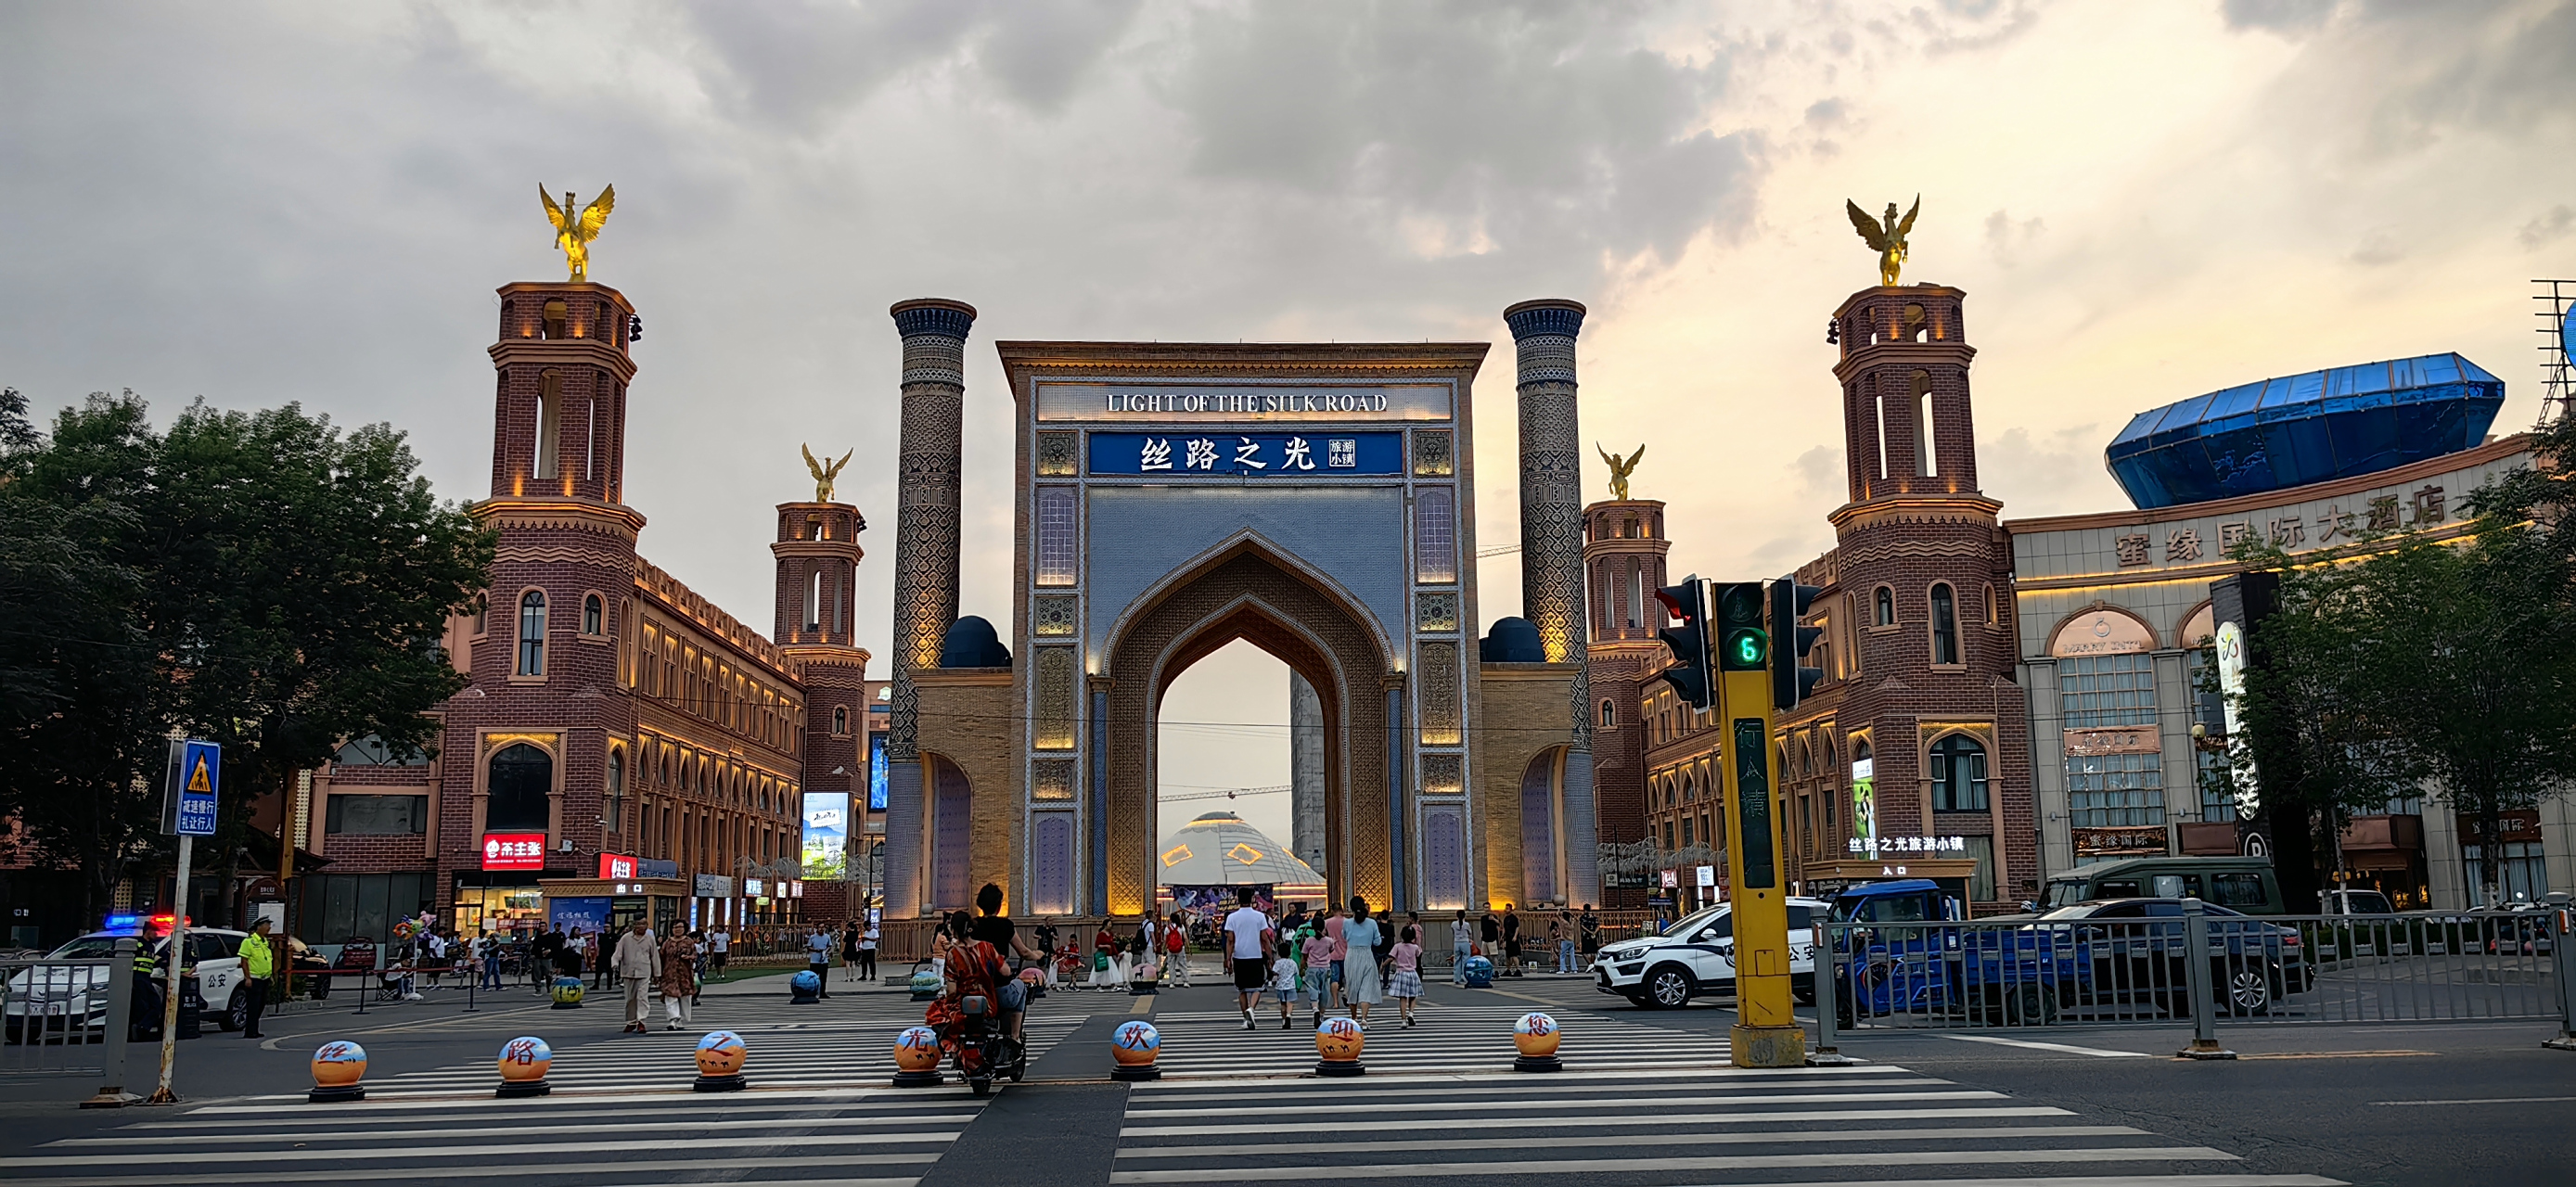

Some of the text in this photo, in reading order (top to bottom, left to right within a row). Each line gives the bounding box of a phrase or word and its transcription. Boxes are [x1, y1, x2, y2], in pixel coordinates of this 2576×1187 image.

[1108, 394, 1387, 412] LIGHT OF THE SILK ROAD
[1141, 437, 1316, 471] 丝路之光
[1330, 440, 1353, 453] 旅游
[1330, 453, 1354, 466] 小镇
[2116, 484, 2444, 567] 蜜缘国际大酒店
[1742, 637, 1756, 662] 6
[183, 799, 214, 814] 减速慢行
[181, 816, 213, 831] 礼让行人
[501, 842, 542, 856] 茶主张
[1849, 836, 1965, 852] 丝路之光旅游小镇
[2090, 834, 2148, 847] 蜜缘国际
[1883, 866, 1906, 875] 入口
[616, 884, 642, 893] 出口
[208, 974, 225, 988] 公安
[1328, 1020, 1354, 1041] 迎
[1525, 1015, 1549, 1037] 您
[706, 1033, 733, 1057] 之
[903, 1029, 929, 1053] 光
[1122, 1024, 1149, 1050] 欢
[317, 1043, 347, 1065] 丝
[506, 1040, 536, 1066] 路
